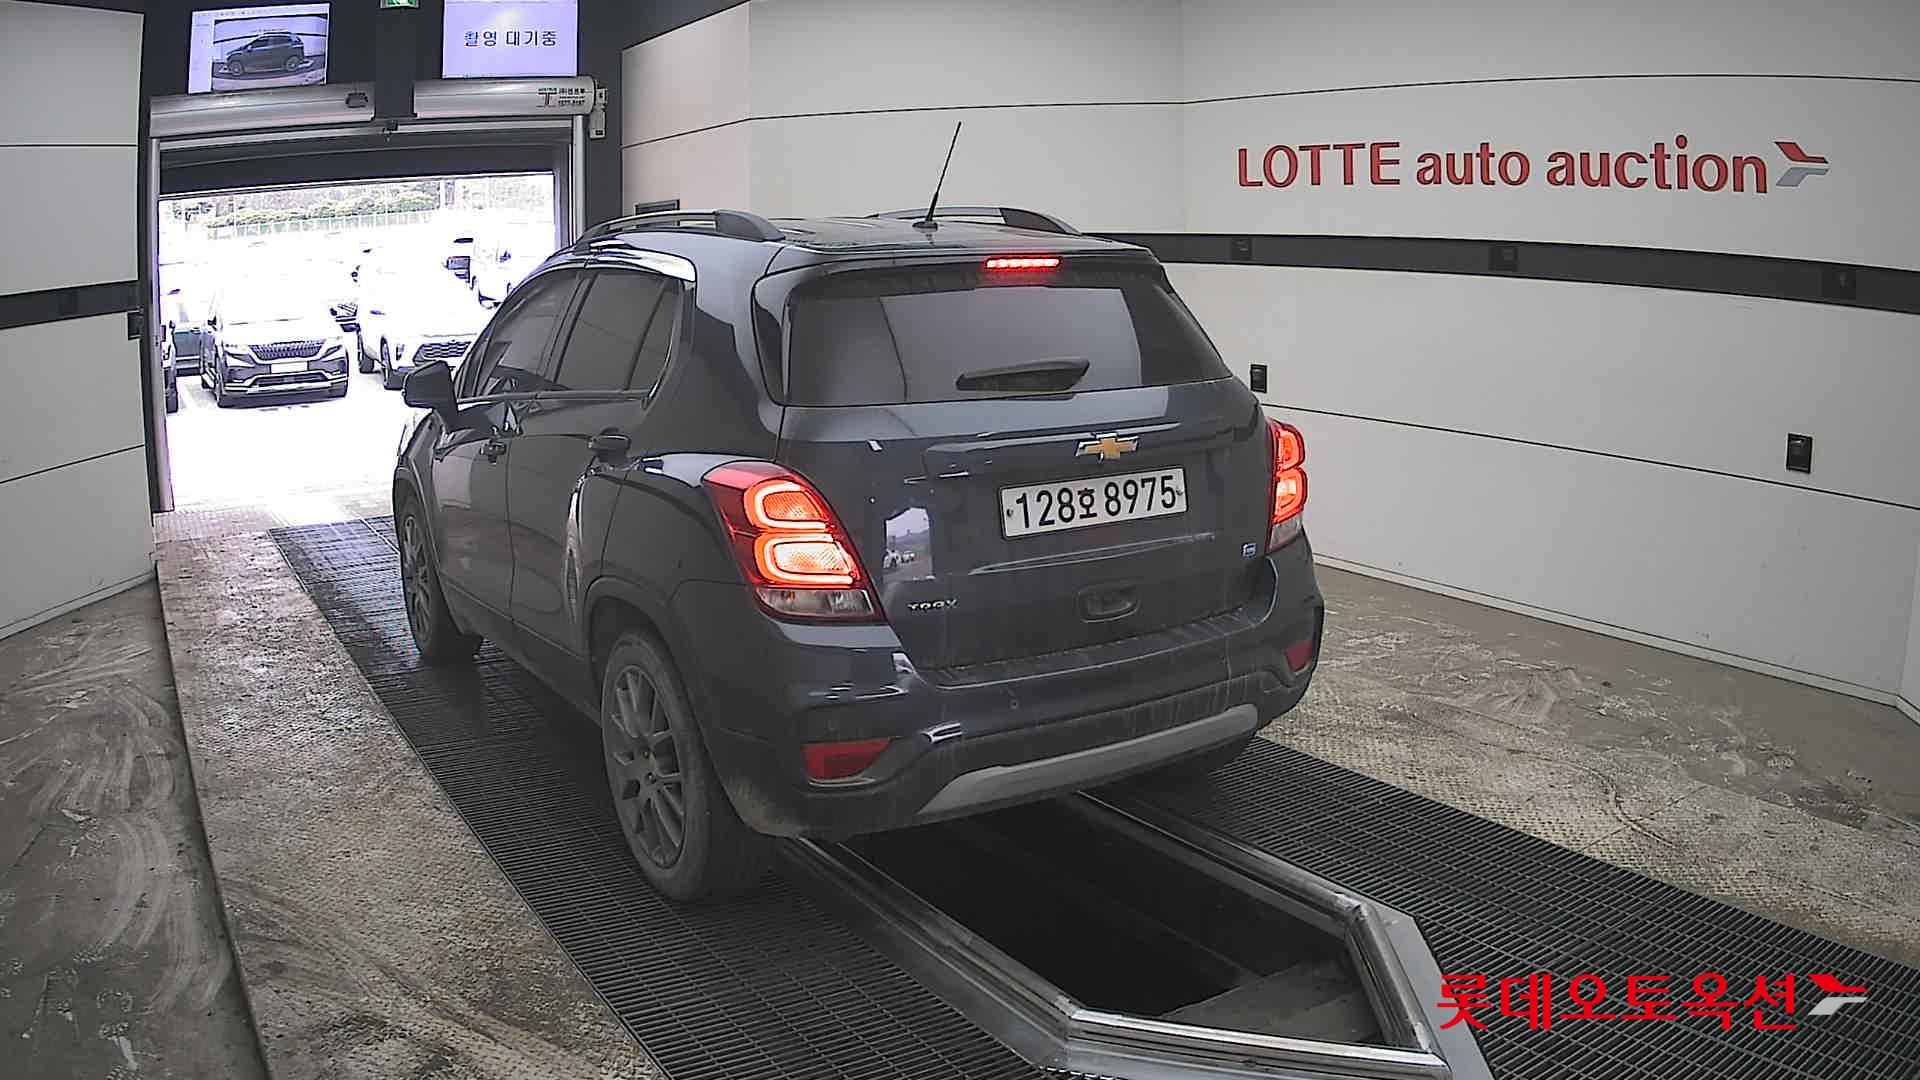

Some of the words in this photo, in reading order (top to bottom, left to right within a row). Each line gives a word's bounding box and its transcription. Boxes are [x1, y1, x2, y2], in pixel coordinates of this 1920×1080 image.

[464, 31, 497, 47] 촬영
[506, 31, 557, 47] 대기중
[1238, 142, 1401, 188] LOTTE
[1416, 142, 1531, 187] auto
[1546, 135, 1768, 194] auction
[1016, 487, 1097, 529] 128호
[1104, 475, 1176, 517] 8975
